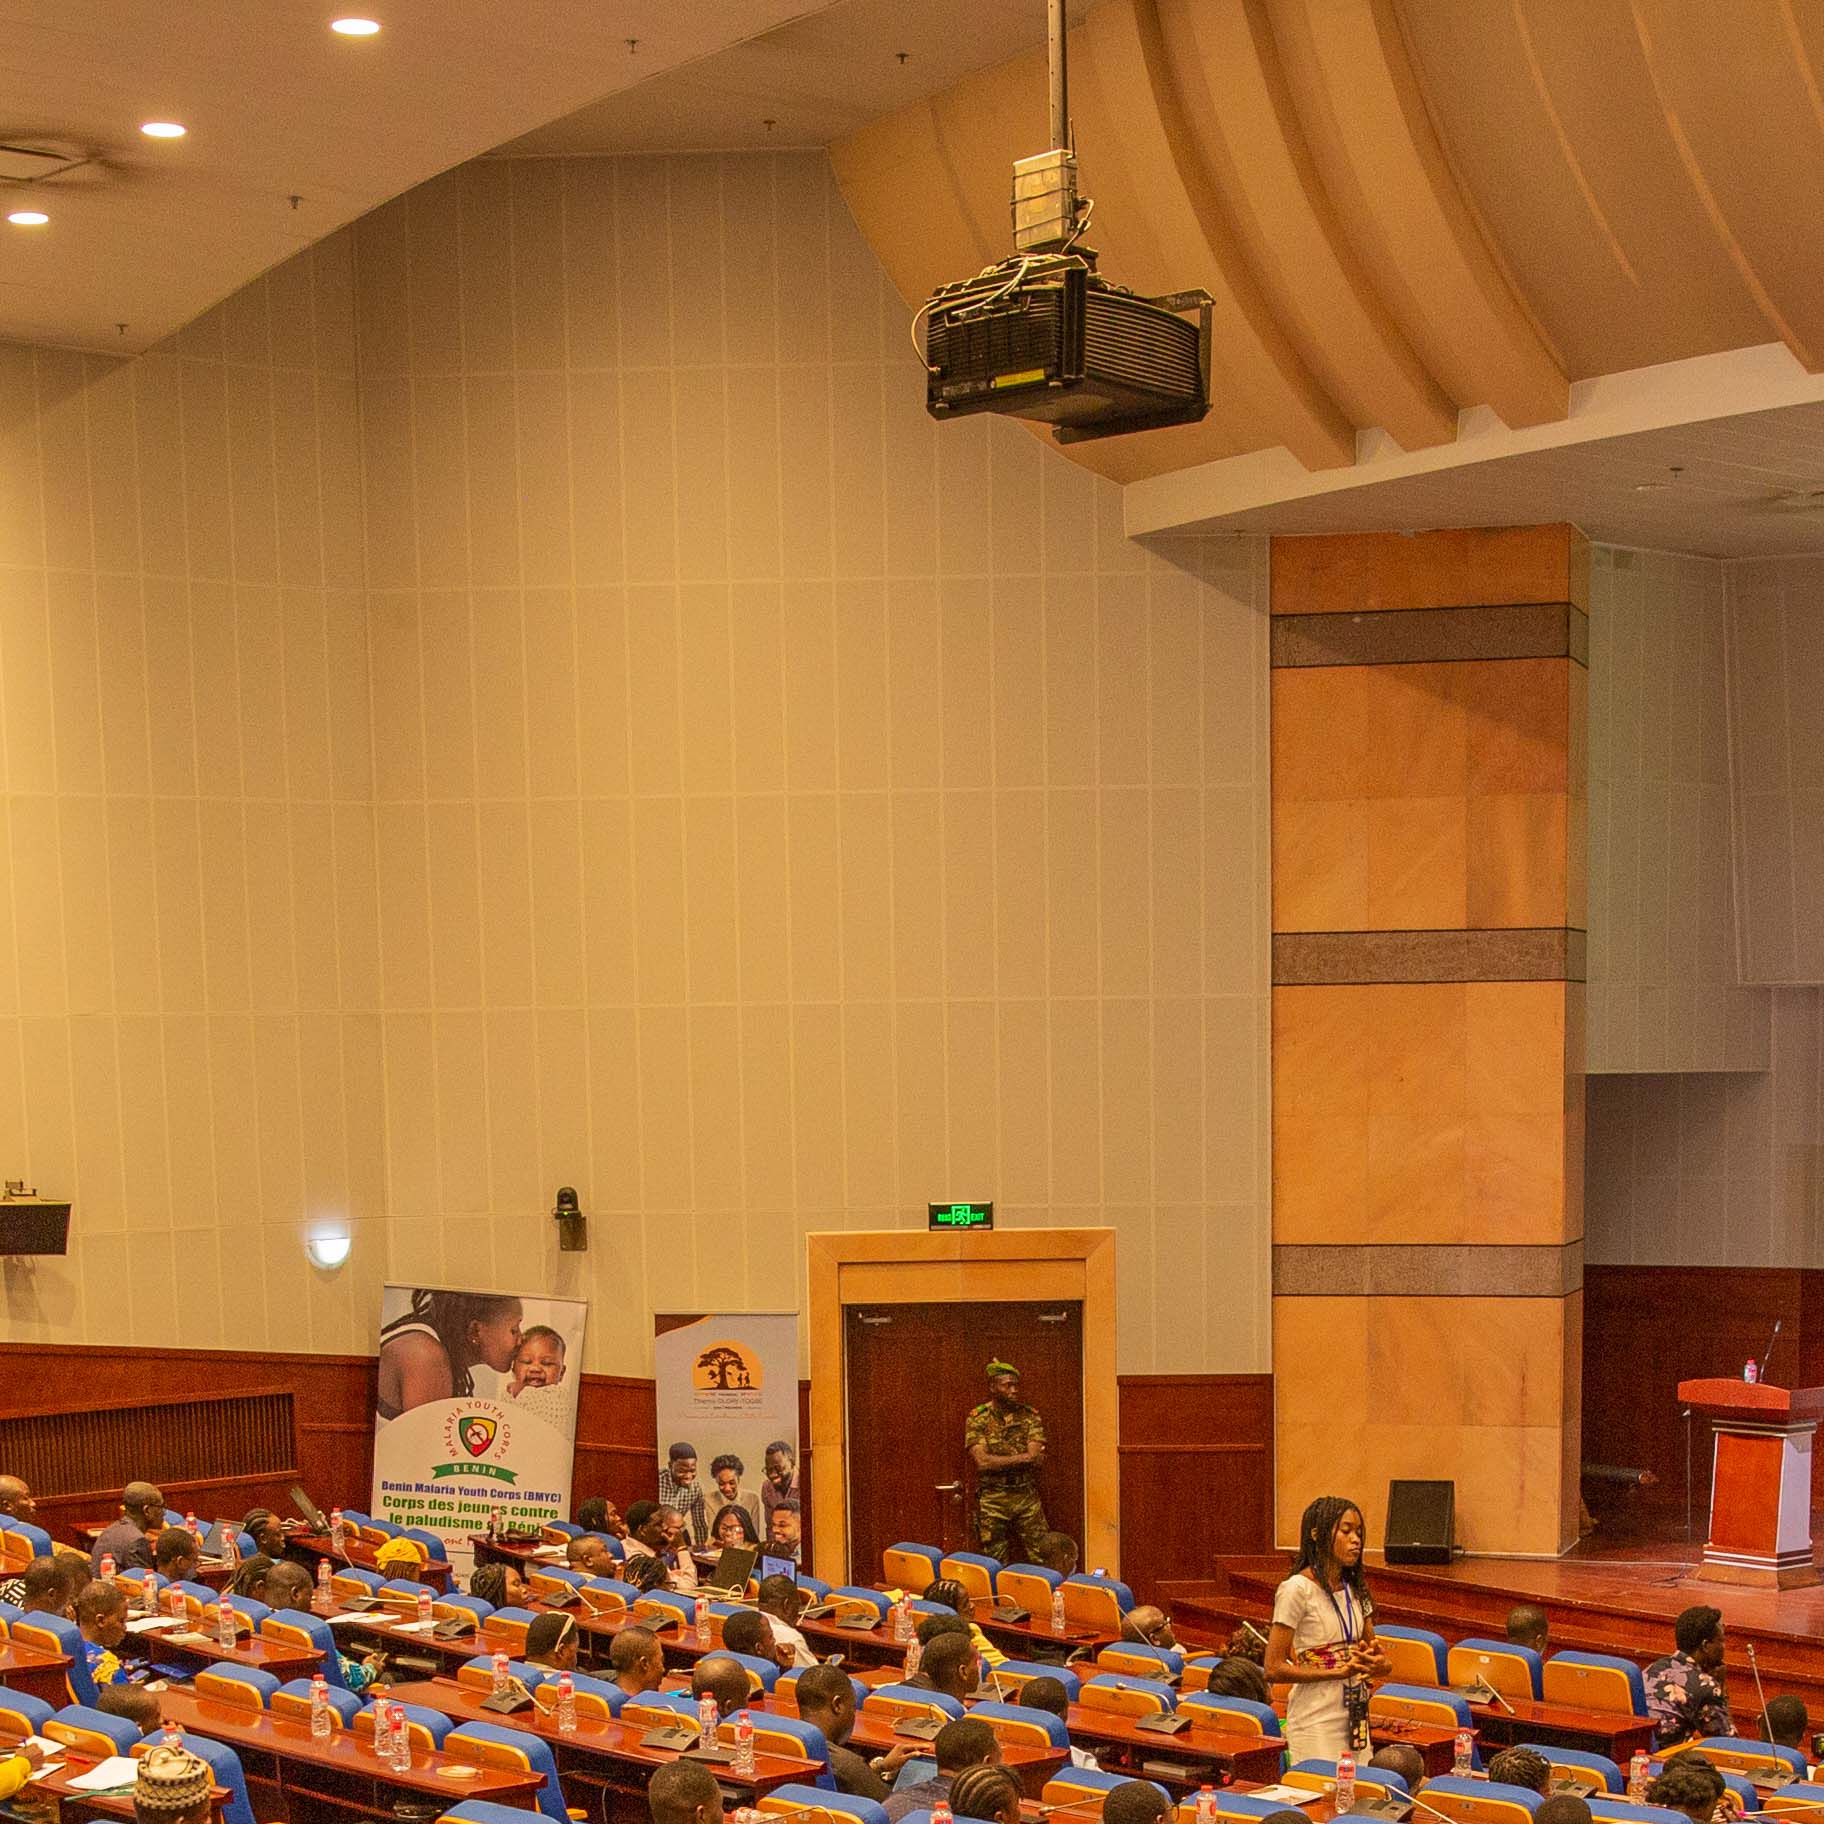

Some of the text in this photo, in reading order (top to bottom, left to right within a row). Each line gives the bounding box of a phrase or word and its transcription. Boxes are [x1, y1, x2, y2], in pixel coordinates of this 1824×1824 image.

[443, 1401, 511, 1459] MALARIA YOUTH CORPS
[453, 1464, 496, 1476] BENIN
[381, 1481, 561, 1503] Benin Malaria Youth Corps (BMYC)
[383, 1495, 425, 1509] Corps
[428, 1498, 454, 1511] des
[511, 1506, 559, 1519] contre
[390, 1512, 402, 1524] le
[406, 1514, 483, 1530] paludisme
